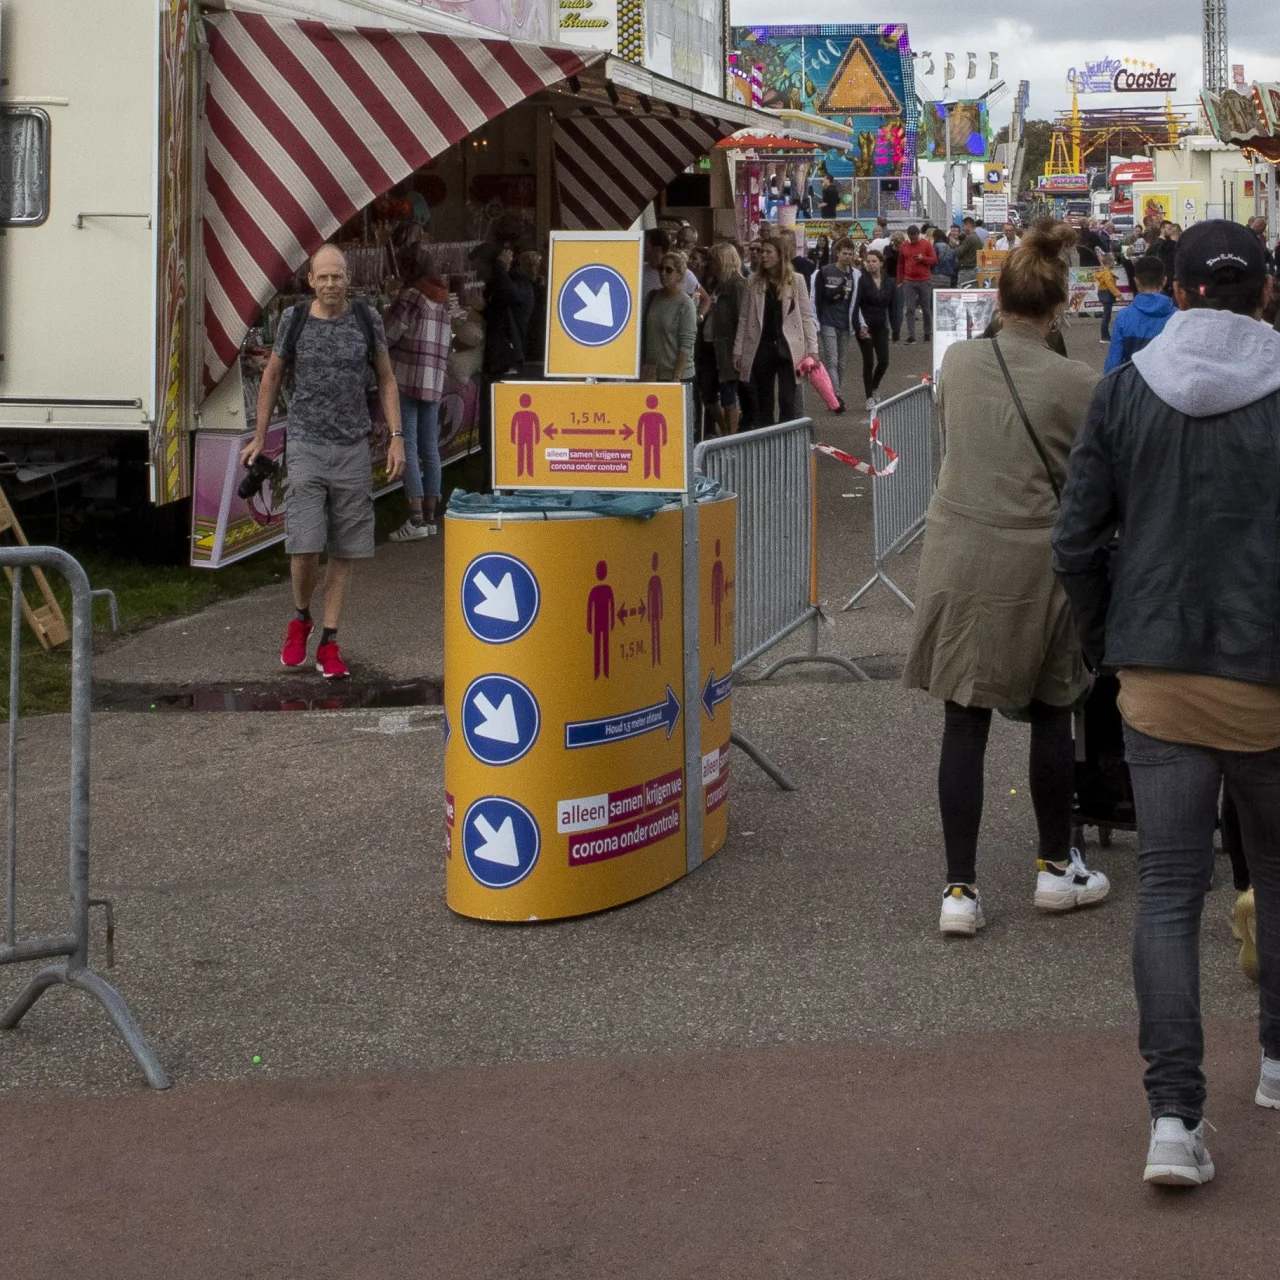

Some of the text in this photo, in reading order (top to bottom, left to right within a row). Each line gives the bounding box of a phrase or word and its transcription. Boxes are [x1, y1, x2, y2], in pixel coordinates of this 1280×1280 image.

[1114, 68, 1177, 92] Coaster
[570, 412, 611, 425] 1,5 M.
[546, 450, 568, 459] alleen
[570, 451, 593, 459] samen
[595, 449, 620, 460] krijgen
[551, 462, 627, 471] corona onder controle
[620, 640, 647, 661] 1,5 M.
[605, 722, 623, 736] Houd
[632, 716, 646, 729] meter
[646, 711, 662, 725] afstand
[562, 777, 682, 826] alleen samen krijgen we
[572, 812, 679, 859] corona onder controle
